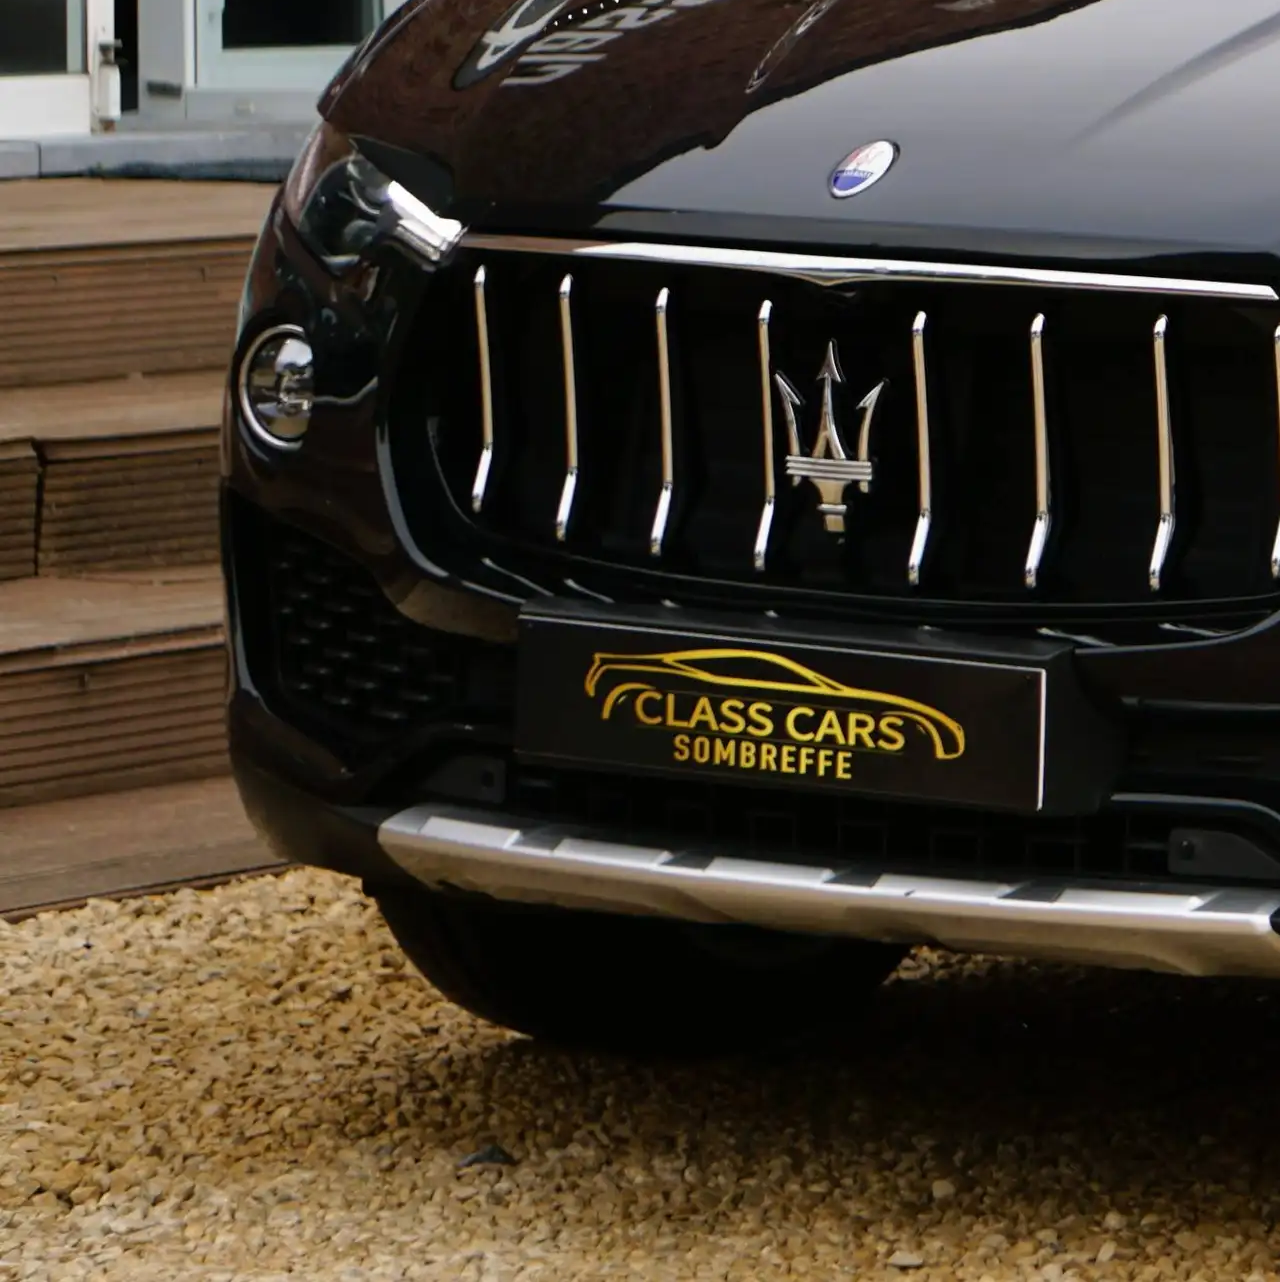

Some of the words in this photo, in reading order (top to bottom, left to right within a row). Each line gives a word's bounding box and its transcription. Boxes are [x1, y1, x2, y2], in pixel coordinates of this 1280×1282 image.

[634, 690, 774, 737] CLASS
[786, 706, 905, 752] CARS
[673, 734, 852, 780] SOMBREFFE
